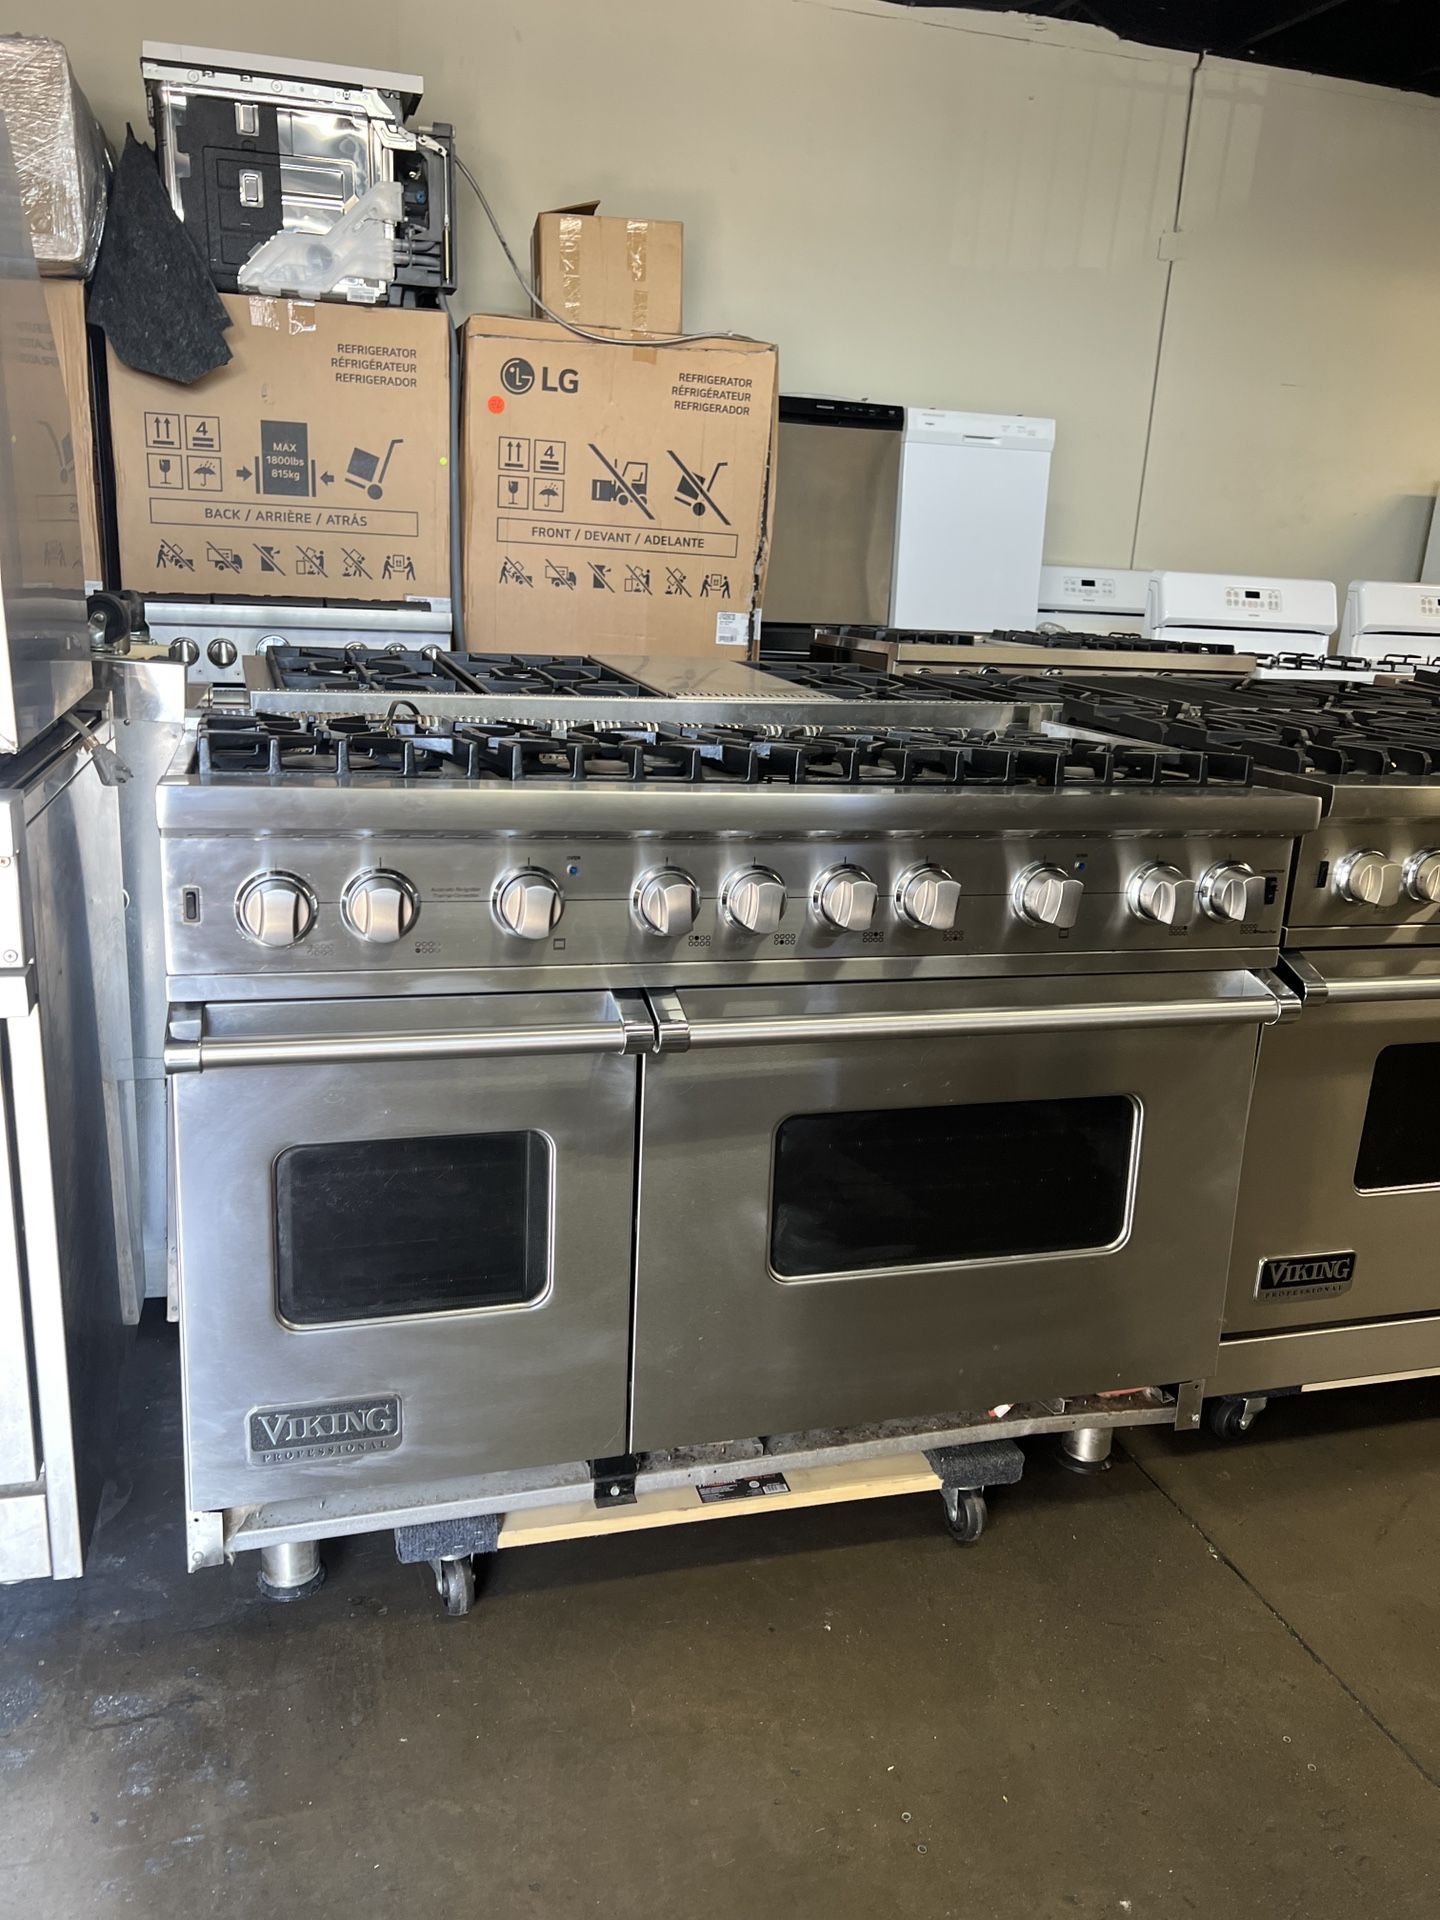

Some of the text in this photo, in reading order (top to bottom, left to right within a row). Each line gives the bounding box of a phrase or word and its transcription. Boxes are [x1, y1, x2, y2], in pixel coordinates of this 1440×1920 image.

[337, 343, 417, 359] REFRIGERATOR
[331, 356, 417, 373] RÉFRIGÉRATEUR
[335, 372, 417, 388] REFRIGERADOR
[542, 366, 579, 394] LG
[679, 372, 753, 388] REFRIGERATOR
[671, 385, 752, 402] RÉFRIGÉRATEUR
[674, 400, 750, 415] REFRIGERADOR
[195, 421, 208, 436] 4
[273, 442, 297, 453] MAX
[544, 446, 555, 459] 4
[266, 455, 305, 467] 1800lbs
[271, 469, 300, 481] 815kg
[204, 508, 368, 527] BACK / ARRIÈRE / ATRÁS
[531, 526, 705, 549] FRONT / DEVANT / ADELANTE
[1268, 1257, 1351, 1287] VIKING
[257, 1404, 393, 1446] VIKING
[262, 1440, 390, 1463] PROFESSIONAL
